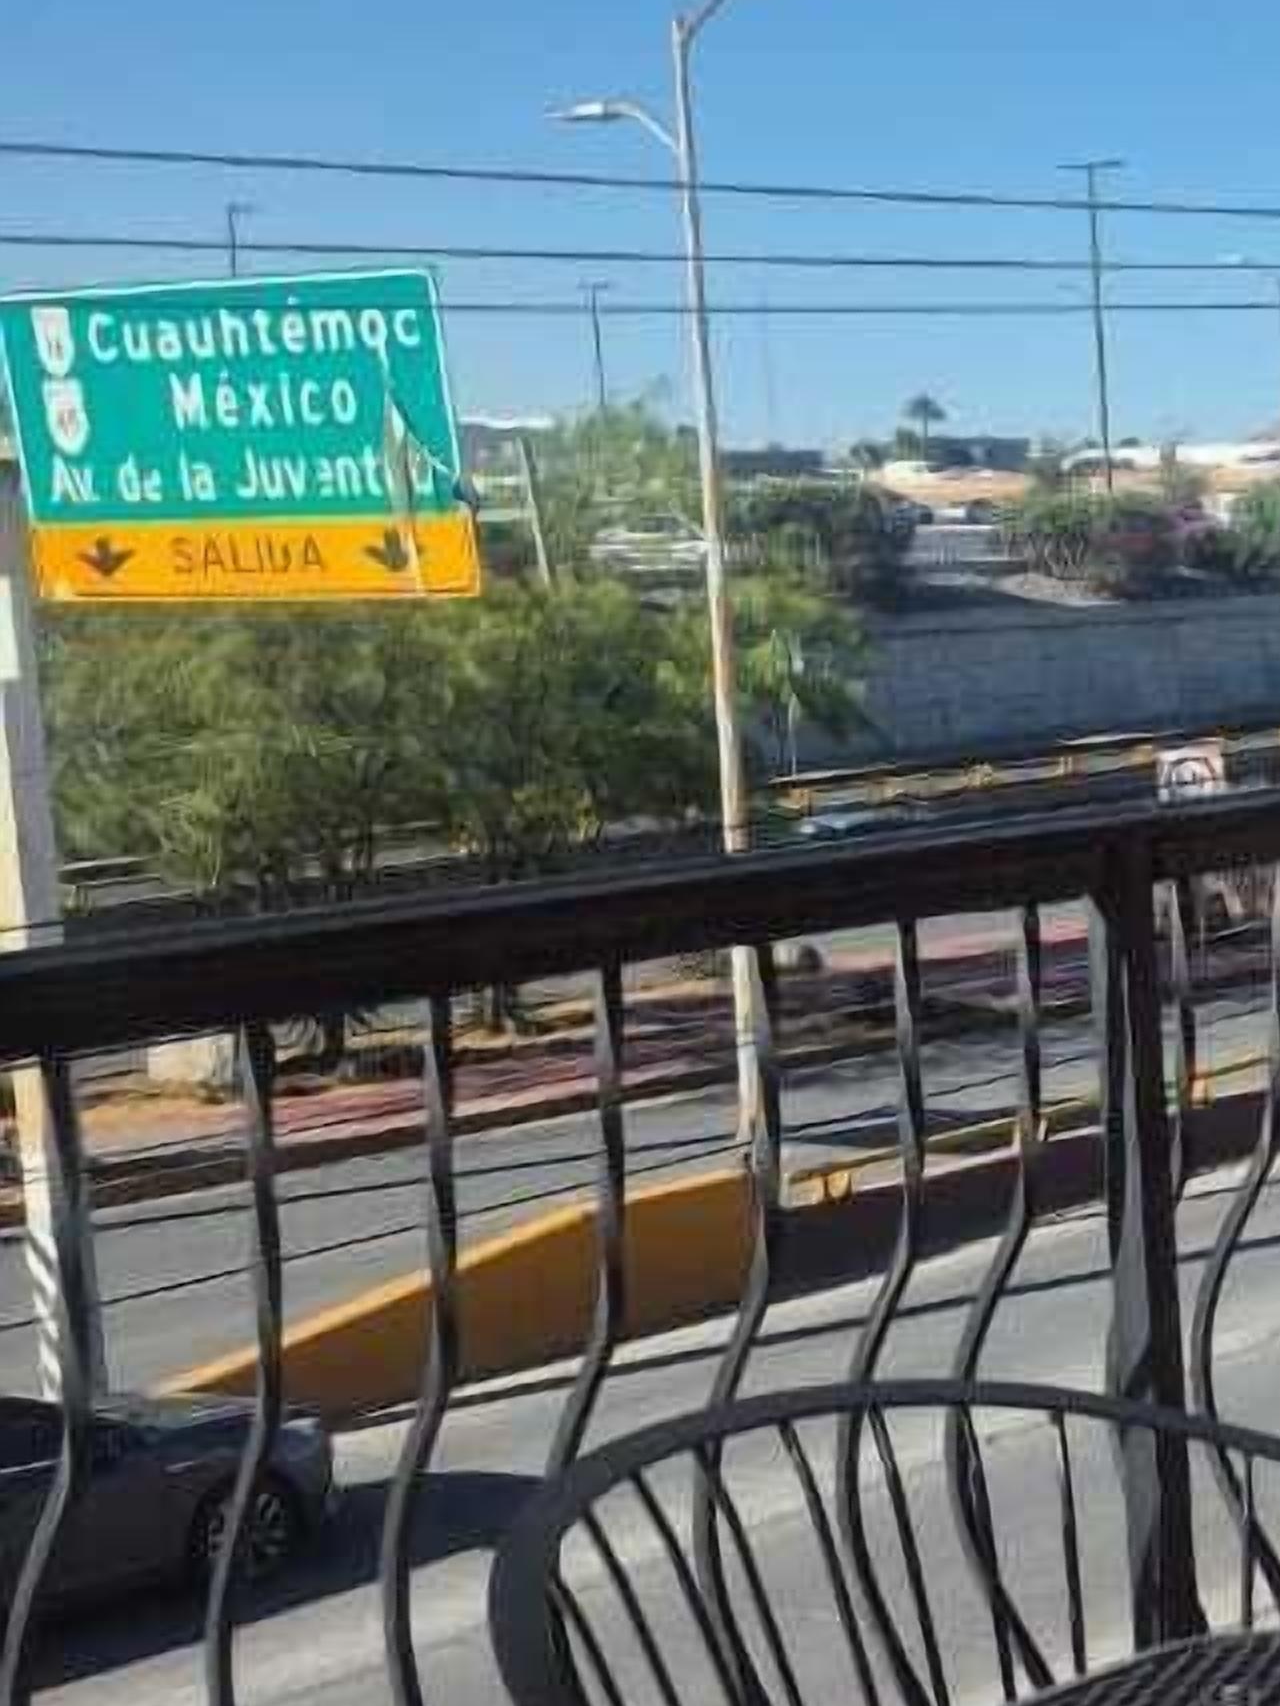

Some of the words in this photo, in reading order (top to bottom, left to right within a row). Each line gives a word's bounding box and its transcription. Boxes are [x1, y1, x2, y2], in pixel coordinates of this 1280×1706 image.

[87, 296, 422, 365] Cuauhtémoc
[169, 370, 357, 430] México
[118, 453, 162, 502] de
[180, 451, 216, 501] la
